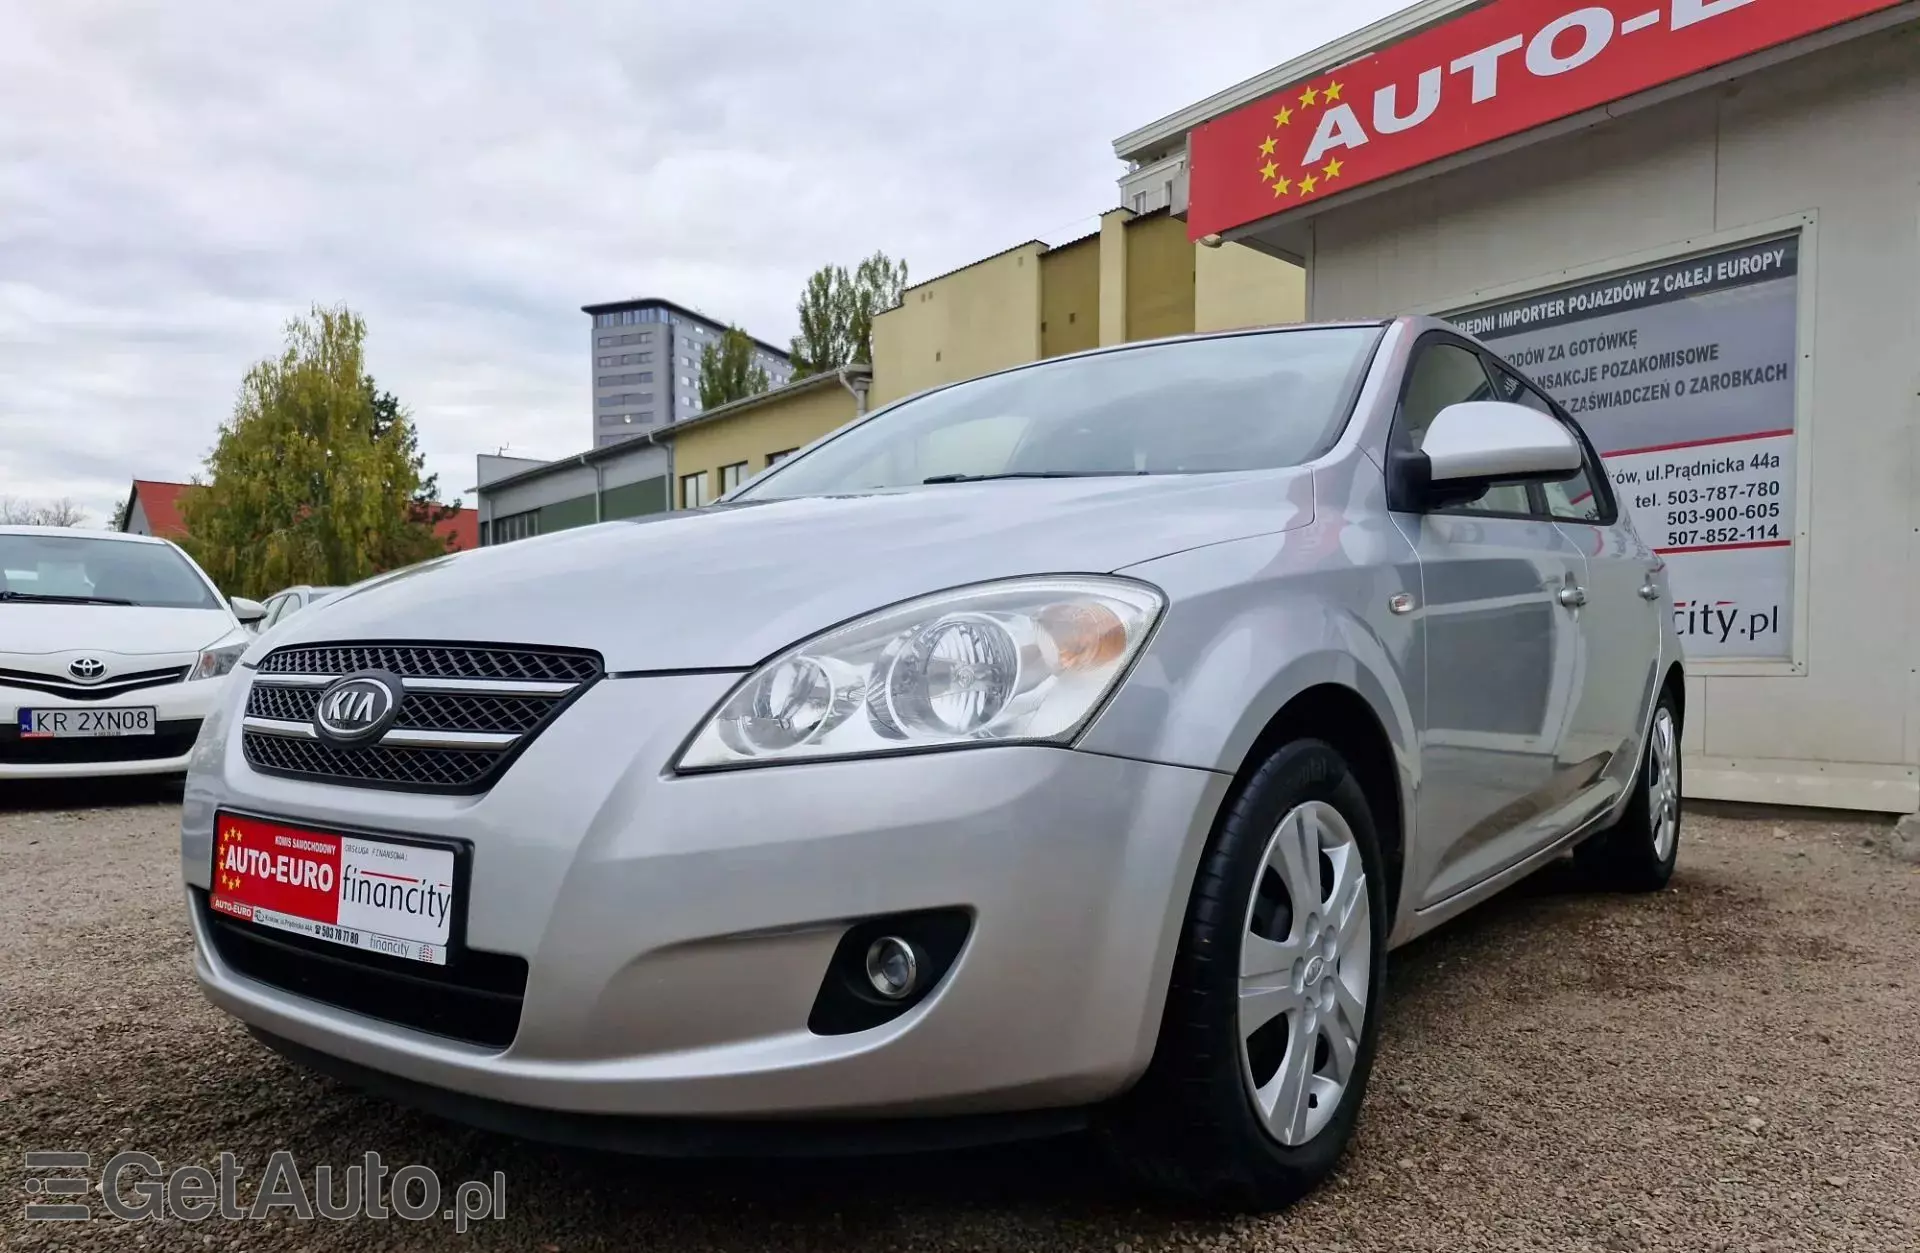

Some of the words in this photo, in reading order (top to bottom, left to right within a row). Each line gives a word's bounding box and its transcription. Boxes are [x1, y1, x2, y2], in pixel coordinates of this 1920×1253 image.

[1499, 299, 1565, 328] IMPORTER
[1568, 280, 1646, 313] POJAZDÓW
[1650, 278, 1660, 296] Z
[1664, 265, 1713, 292] CAŁEJ
[1717, 249, 1785, 281] EUROPY
[1504, 347, 1545, 368] ODÓW
[1548, 345, 1565, 362] ZA
[1569, 329, 1638, 357] GOTÓWKĘ
[1532, 366, 1598, 391] NSAKCJE
[1602, 343, 1719, 380] POZAKOMISOWE
[1571, 379, 1670, 413] ZAŚWIADCZEŃ
[1675, 380, 1685, 396] O
[1690, 363, 1787, 394] ZAROBKACH
[1611, 468, 1641, 486] ów,
[1646, 457, 1745, 481] ul.Prądnicka
[1750, 452, 1780, 469] 44a
[1635, 494, 1661, 508] tel.
[1667, 481, 1780, 505] 503-787-780
[1667, 502, 1780, 526] 503-900-605
[1667, 524, 1779, 546] 507-852-114
[328, 691, 375, 722] KIA
[37, 712, 67, 732] KR
[78, 711, 149, 731] 2XN08
[292, 838, 337, 855] SAMOCHODOWY
[225, 844, 334, 892] AUTO-EURO
[215, 899, 252, 917] AUTO-EURO
[343, 864, 451, 928] financity
[322, 926, 334, 939] 503
[334, 928, 342, 941] 78
[343, 931, 350, 943] 77
[350, 933, 359, 945] 80
[370, 934, 410, 958] financity
